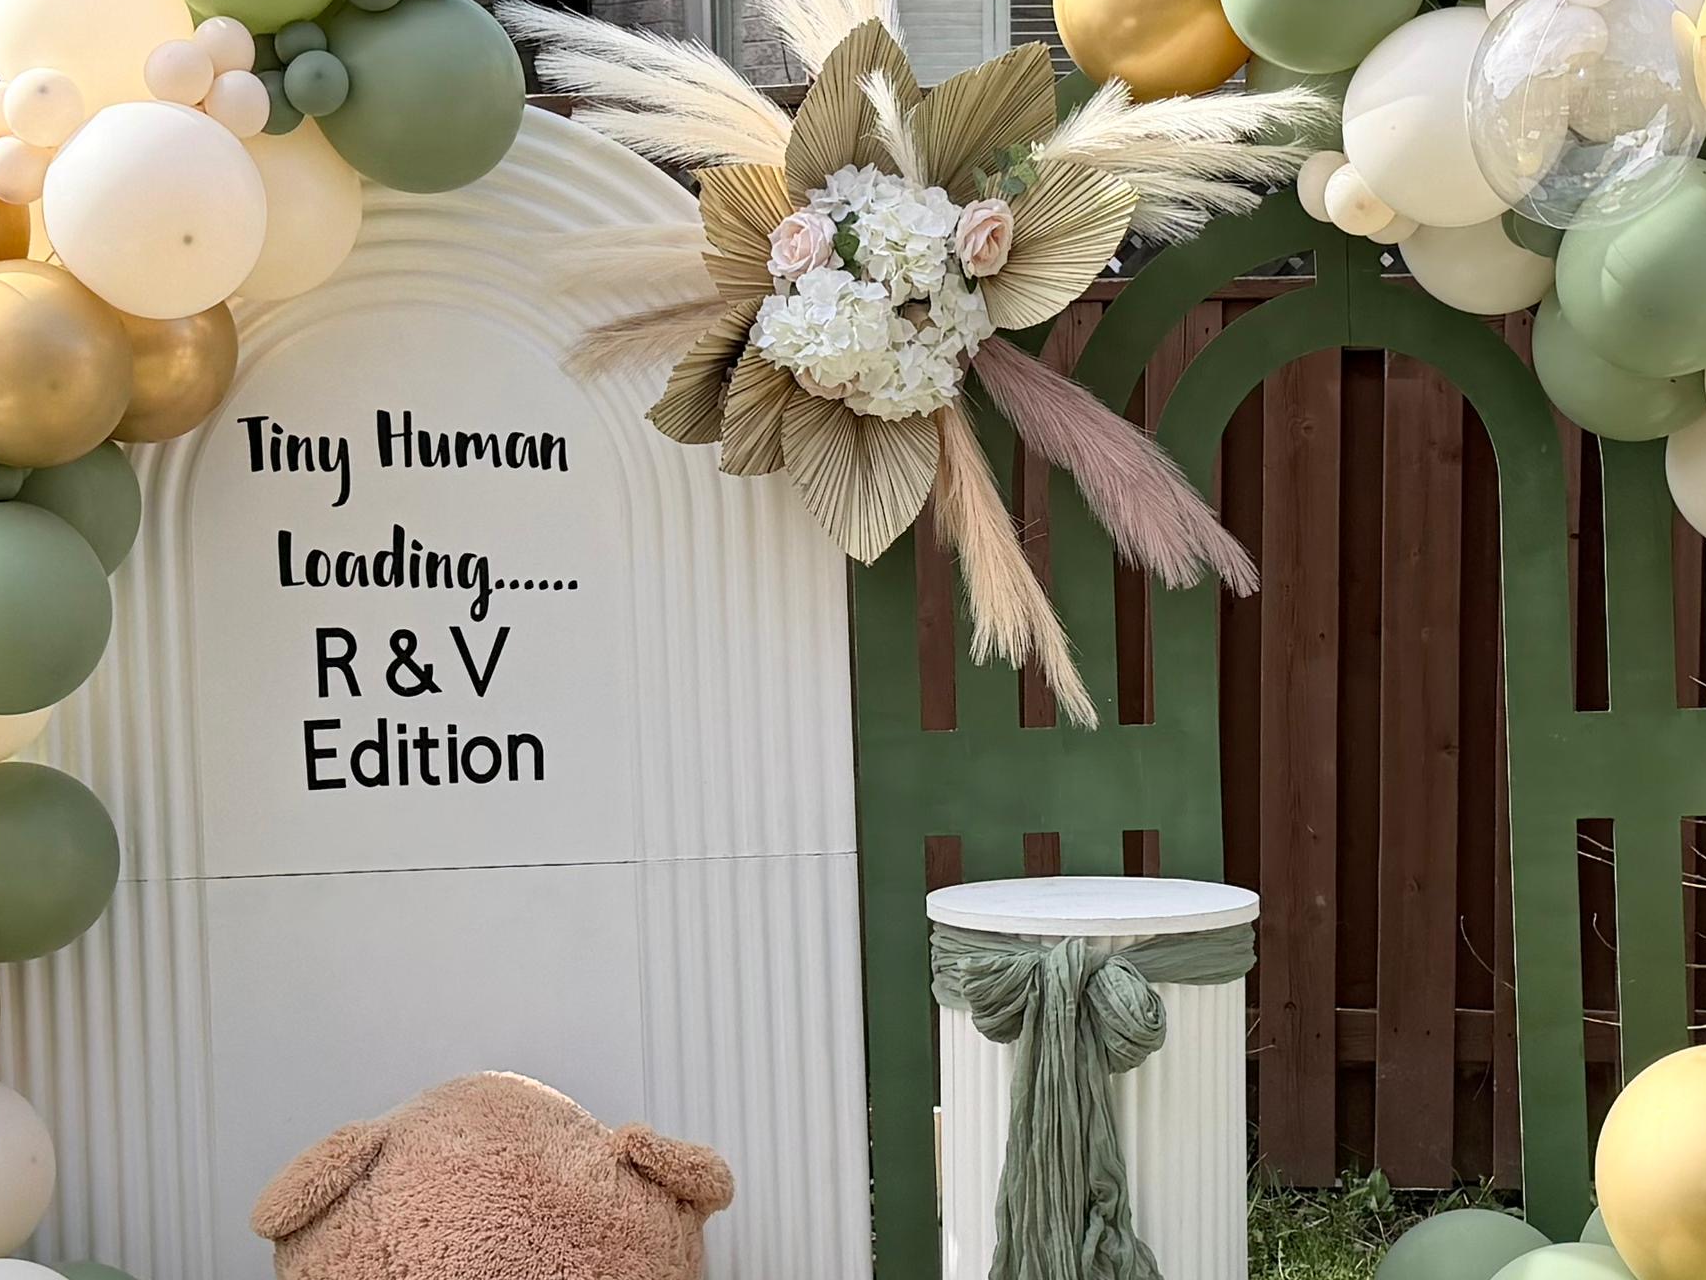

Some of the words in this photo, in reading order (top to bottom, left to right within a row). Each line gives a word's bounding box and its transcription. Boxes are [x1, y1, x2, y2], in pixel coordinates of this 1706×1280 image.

[236, 415, 351, 508] Tiny
[376, 409, 569, 472] Human
[315, 627, 362, 698] R
[385, 628, 443, 698] &
[448, 626, 511, 698] V
[303, 717, 544, 791] Edition
